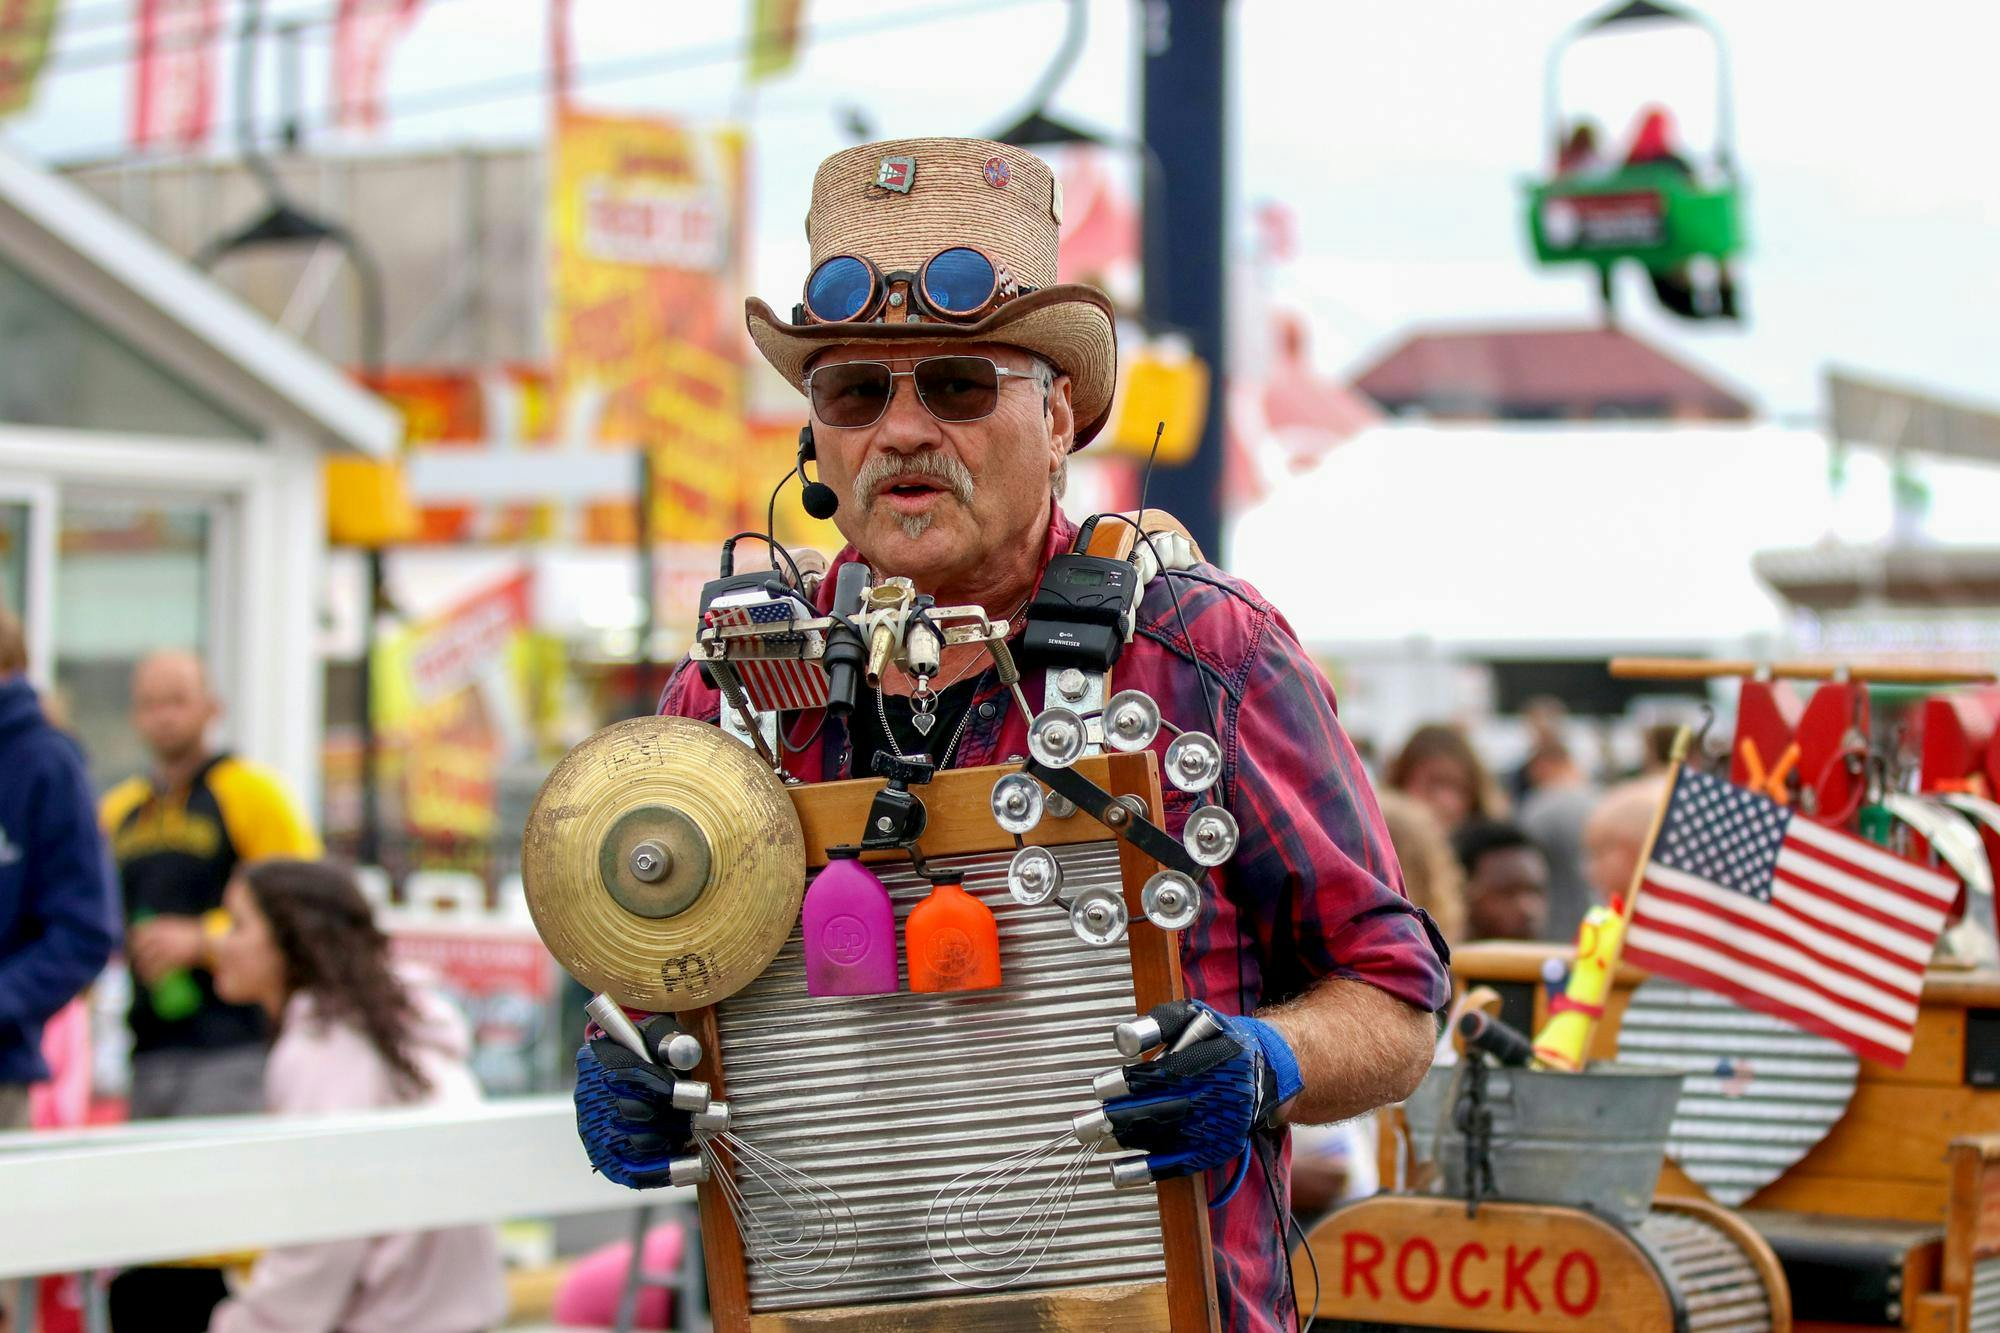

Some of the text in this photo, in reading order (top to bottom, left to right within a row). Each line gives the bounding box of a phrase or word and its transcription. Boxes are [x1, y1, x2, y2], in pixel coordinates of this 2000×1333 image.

[1048, 638, 1080, 647] SENNHEISER
[828, 926, 866, 957] LP
[1341, 1231, 1599, 1318] ROCKO
